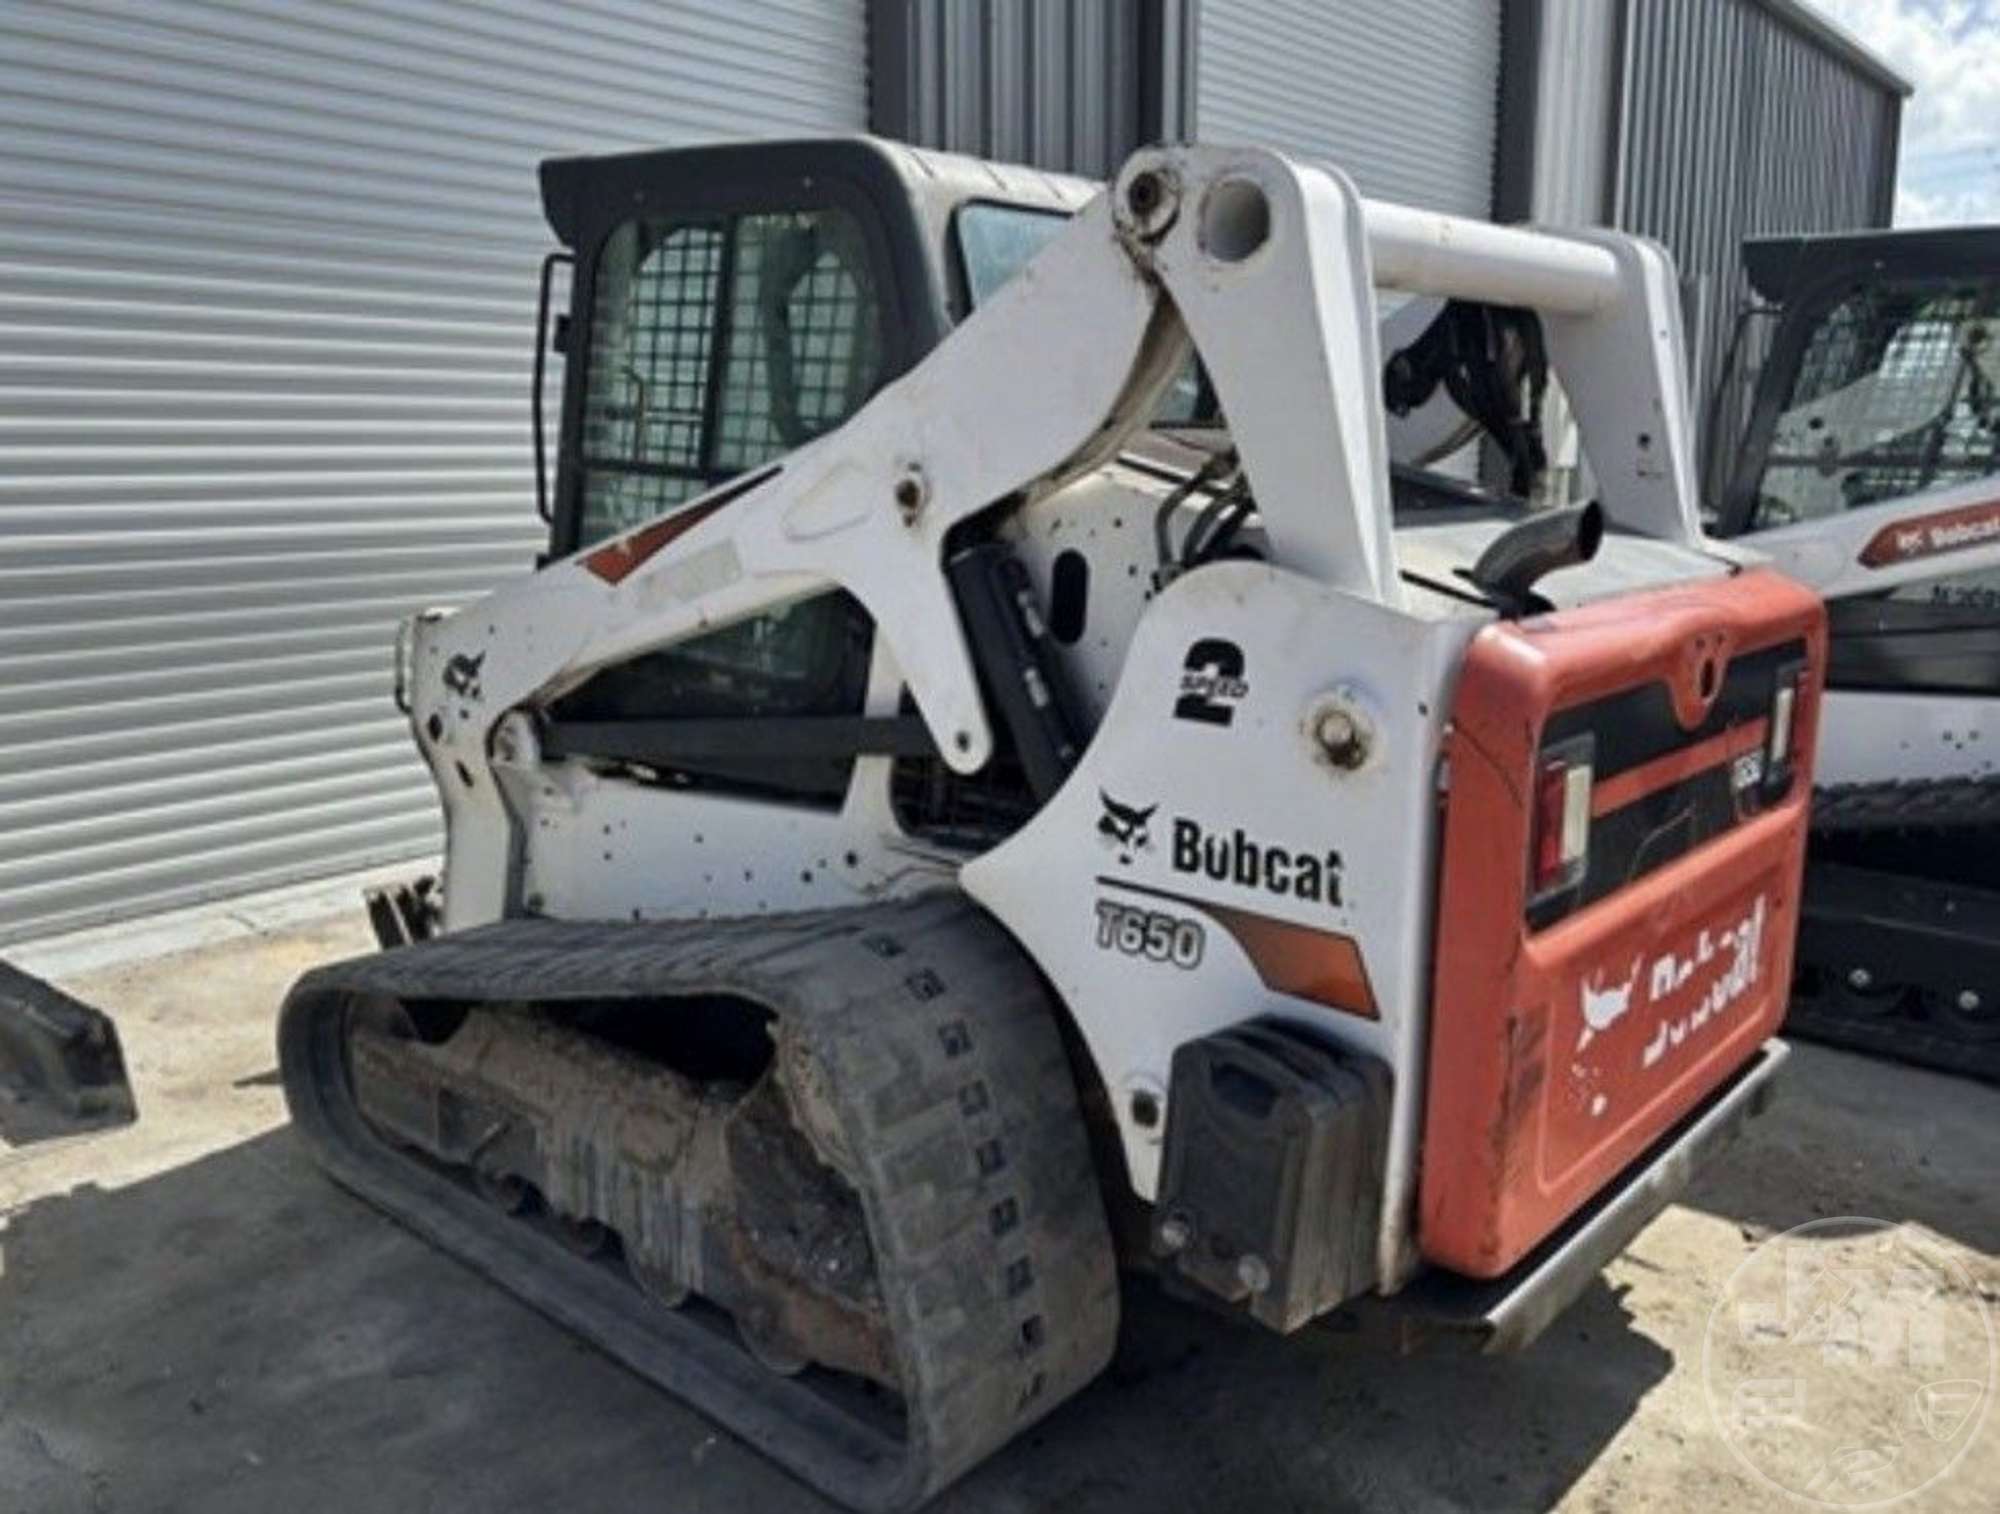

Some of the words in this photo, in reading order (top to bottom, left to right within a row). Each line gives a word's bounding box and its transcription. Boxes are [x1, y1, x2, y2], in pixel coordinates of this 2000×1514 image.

[1174, 638, 1245, 728] 2
[1173, 817, 1343, 908] Bobcat
[1096, 899, 1206, 970] T650
